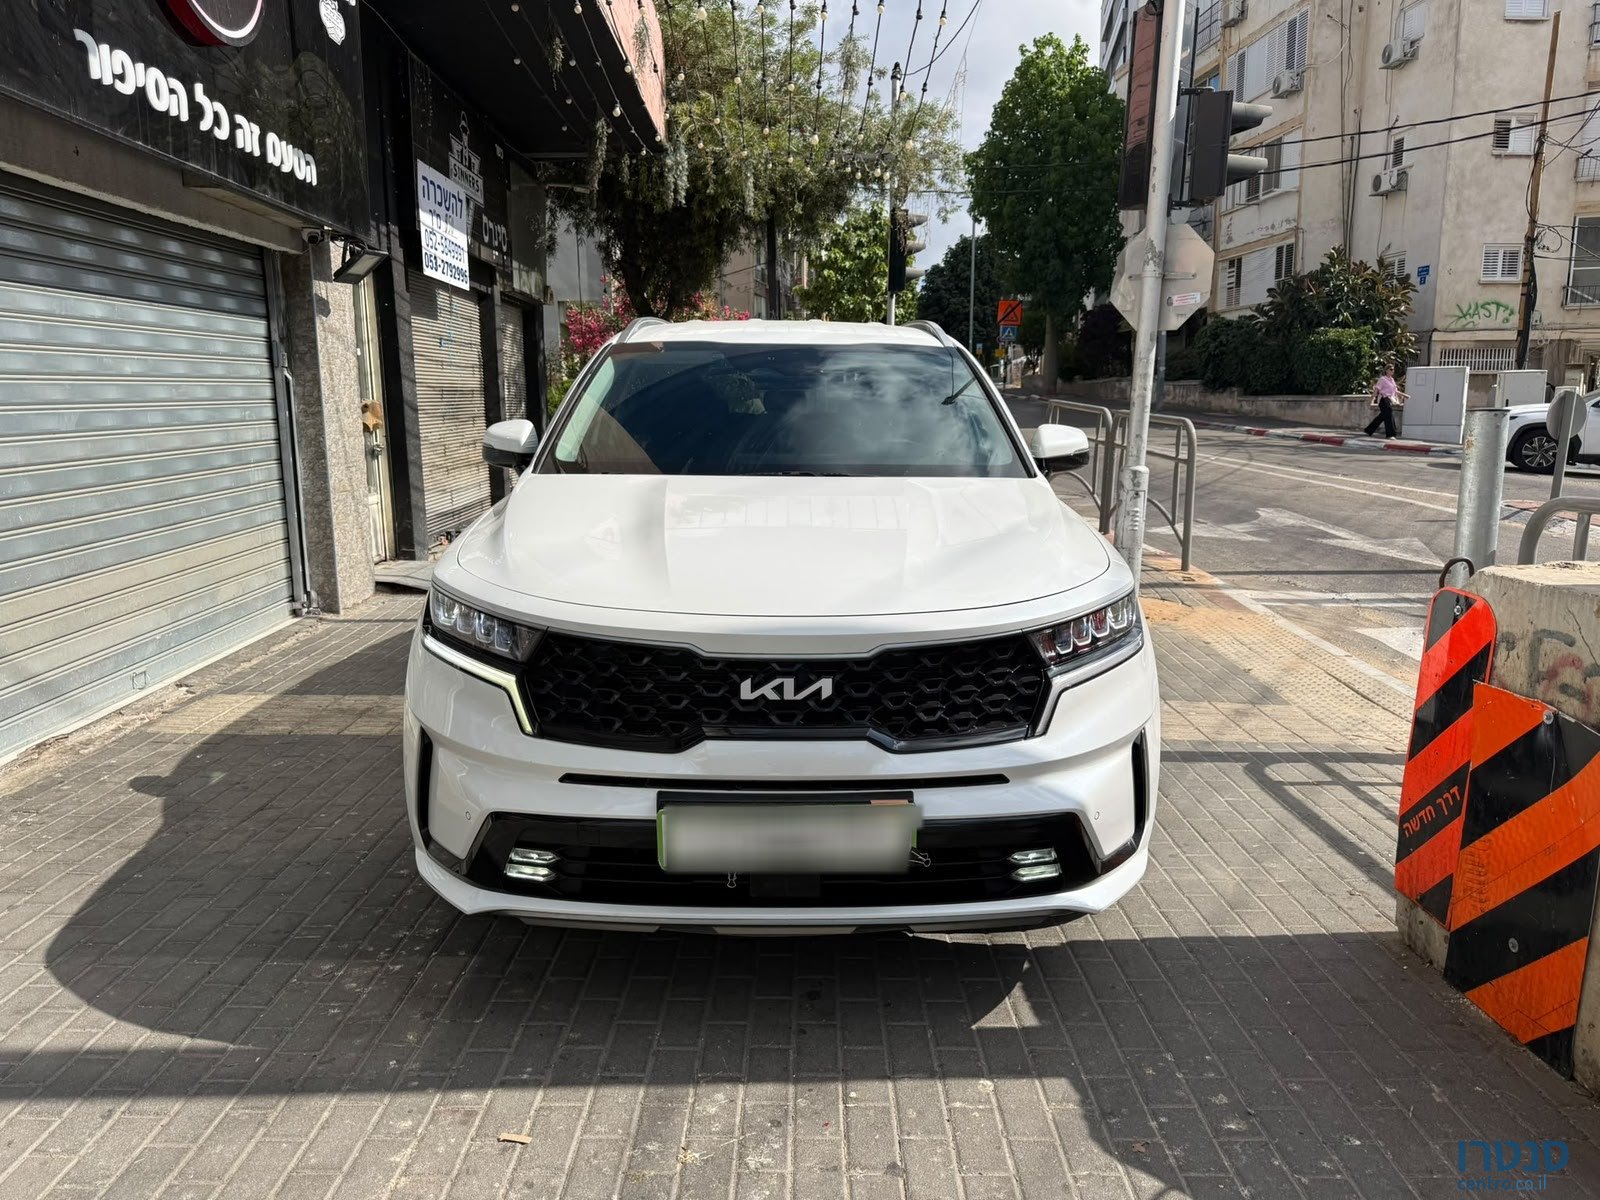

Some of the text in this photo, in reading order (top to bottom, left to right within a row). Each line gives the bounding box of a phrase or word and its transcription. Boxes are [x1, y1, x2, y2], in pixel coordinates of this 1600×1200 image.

[73, 28, 317, 187] הטעם זה כל הסיפור
[421, 174, 464, 219] להשכרה
[453, 162, 480, 193] SINNERS
[740, 677, 833, 700] KIA
[1402, 785, 1461, 839] דרך חדשה
